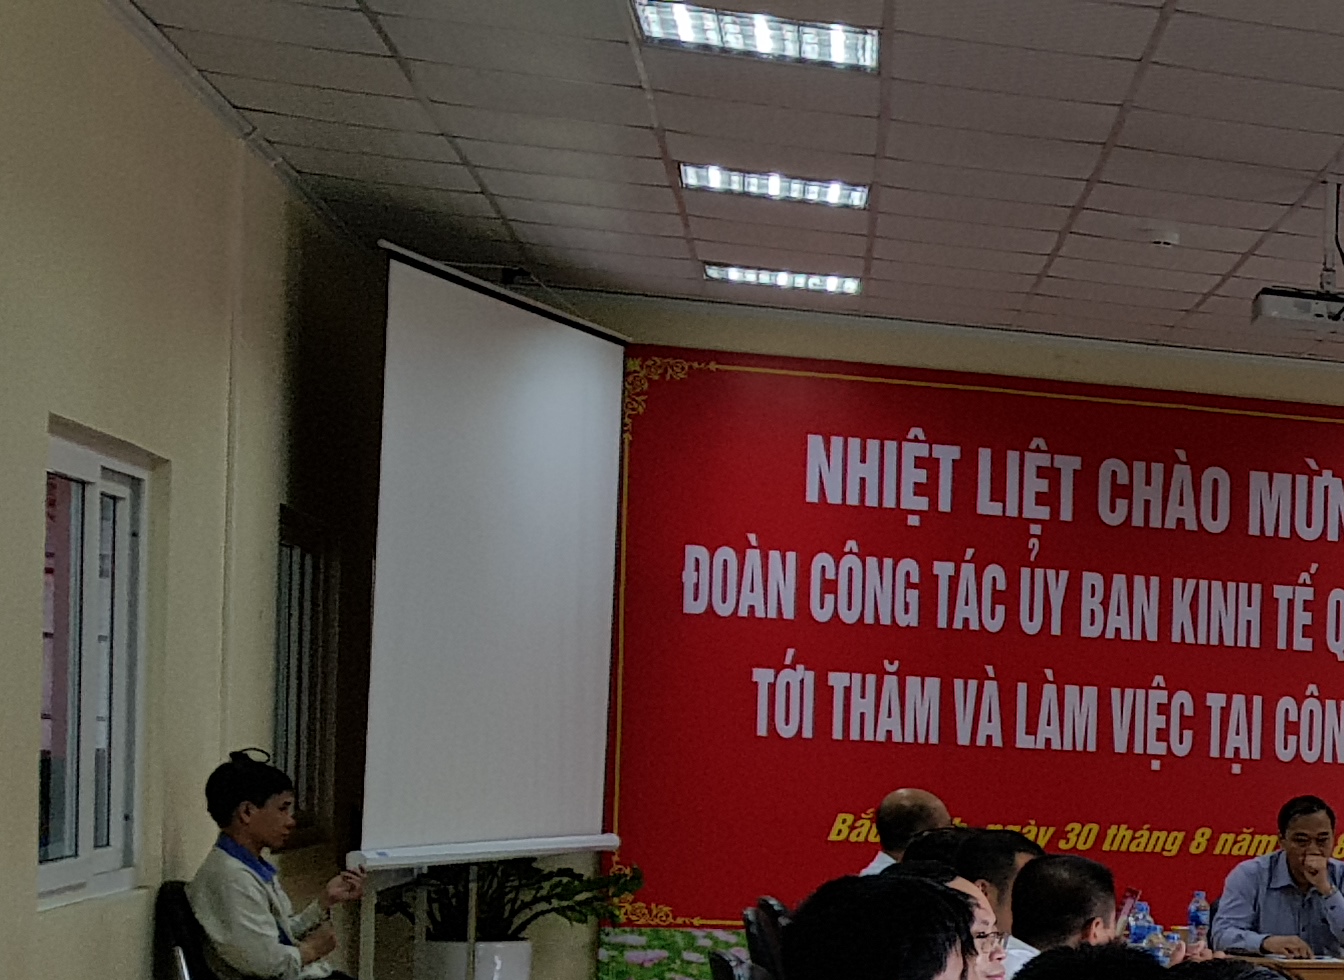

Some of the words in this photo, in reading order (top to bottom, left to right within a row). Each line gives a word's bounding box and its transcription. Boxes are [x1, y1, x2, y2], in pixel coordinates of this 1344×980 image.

[805, 426, 962, 527] NHIỆT
[976, 436, 1083, 536] LIỆT
[1097, 448, 1231, 535] CHÀO
[681, 532, 797, 621] ĐOÀN
[809, 539, 921, 628] CÔNG
[932, 547, 1007, 634] TÁC
[1018, 537, 1070, 636] ỦY
[1079, 570, 1161, 643] BAN
[1170, 577, 1263, 649] KINH
[1272, 562, 1319, 653] TẾ
[751, 647, 815, 739] TỚI
[827, 659, 942, 745] THĂM
[953, 664, 1004, 748] VÀ
[1015, 668, 1099, 753] LÀM
[1110, 674, 1195, 772] VIỆC
[1205, 691, 1264, 776] TẠI
[1057, 822, 1100, 851] 30
[1102, 823, 1186, 858] tháng
[1188, 827, 1213, 855] 8
[1212, 827, 1278, 857] năm
